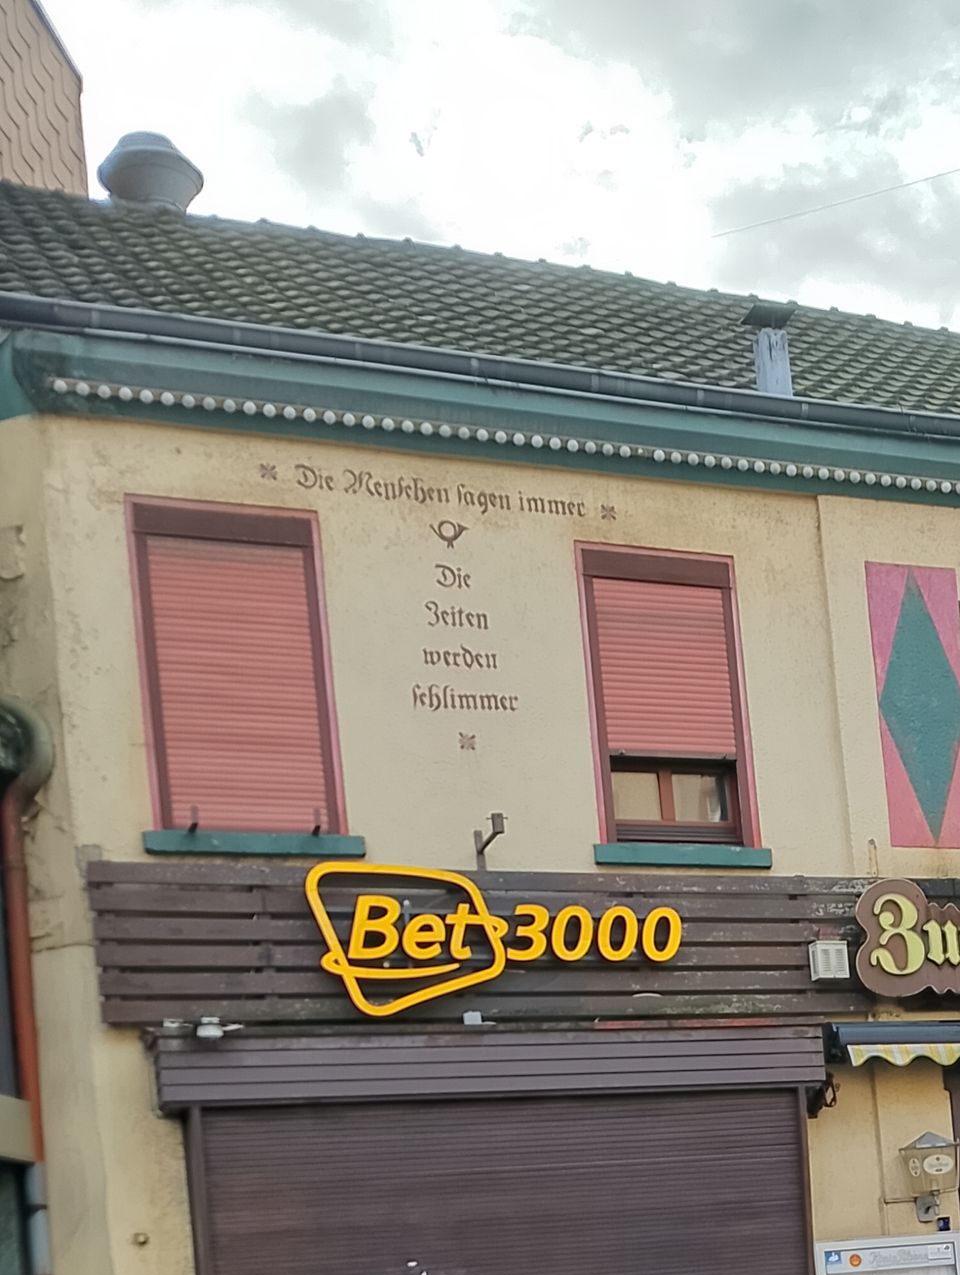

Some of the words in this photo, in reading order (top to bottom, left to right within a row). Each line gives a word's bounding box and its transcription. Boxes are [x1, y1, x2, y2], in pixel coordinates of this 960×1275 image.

[295, 464, 335, 491] Die
[343, 469, 451, 504] Menschen
[457, 483, 512, 515] sagen
[519, 490, 587, 518] immer
[435, 563, 472, 589] Die
[424, 600, 489, 630] Zeiten
[422, 643, 498, 670] werden
[412, 683, 519, 712] schlimmer
[347, 894, 474, 960] Bet
[506, 904, 683, 962] 3000
